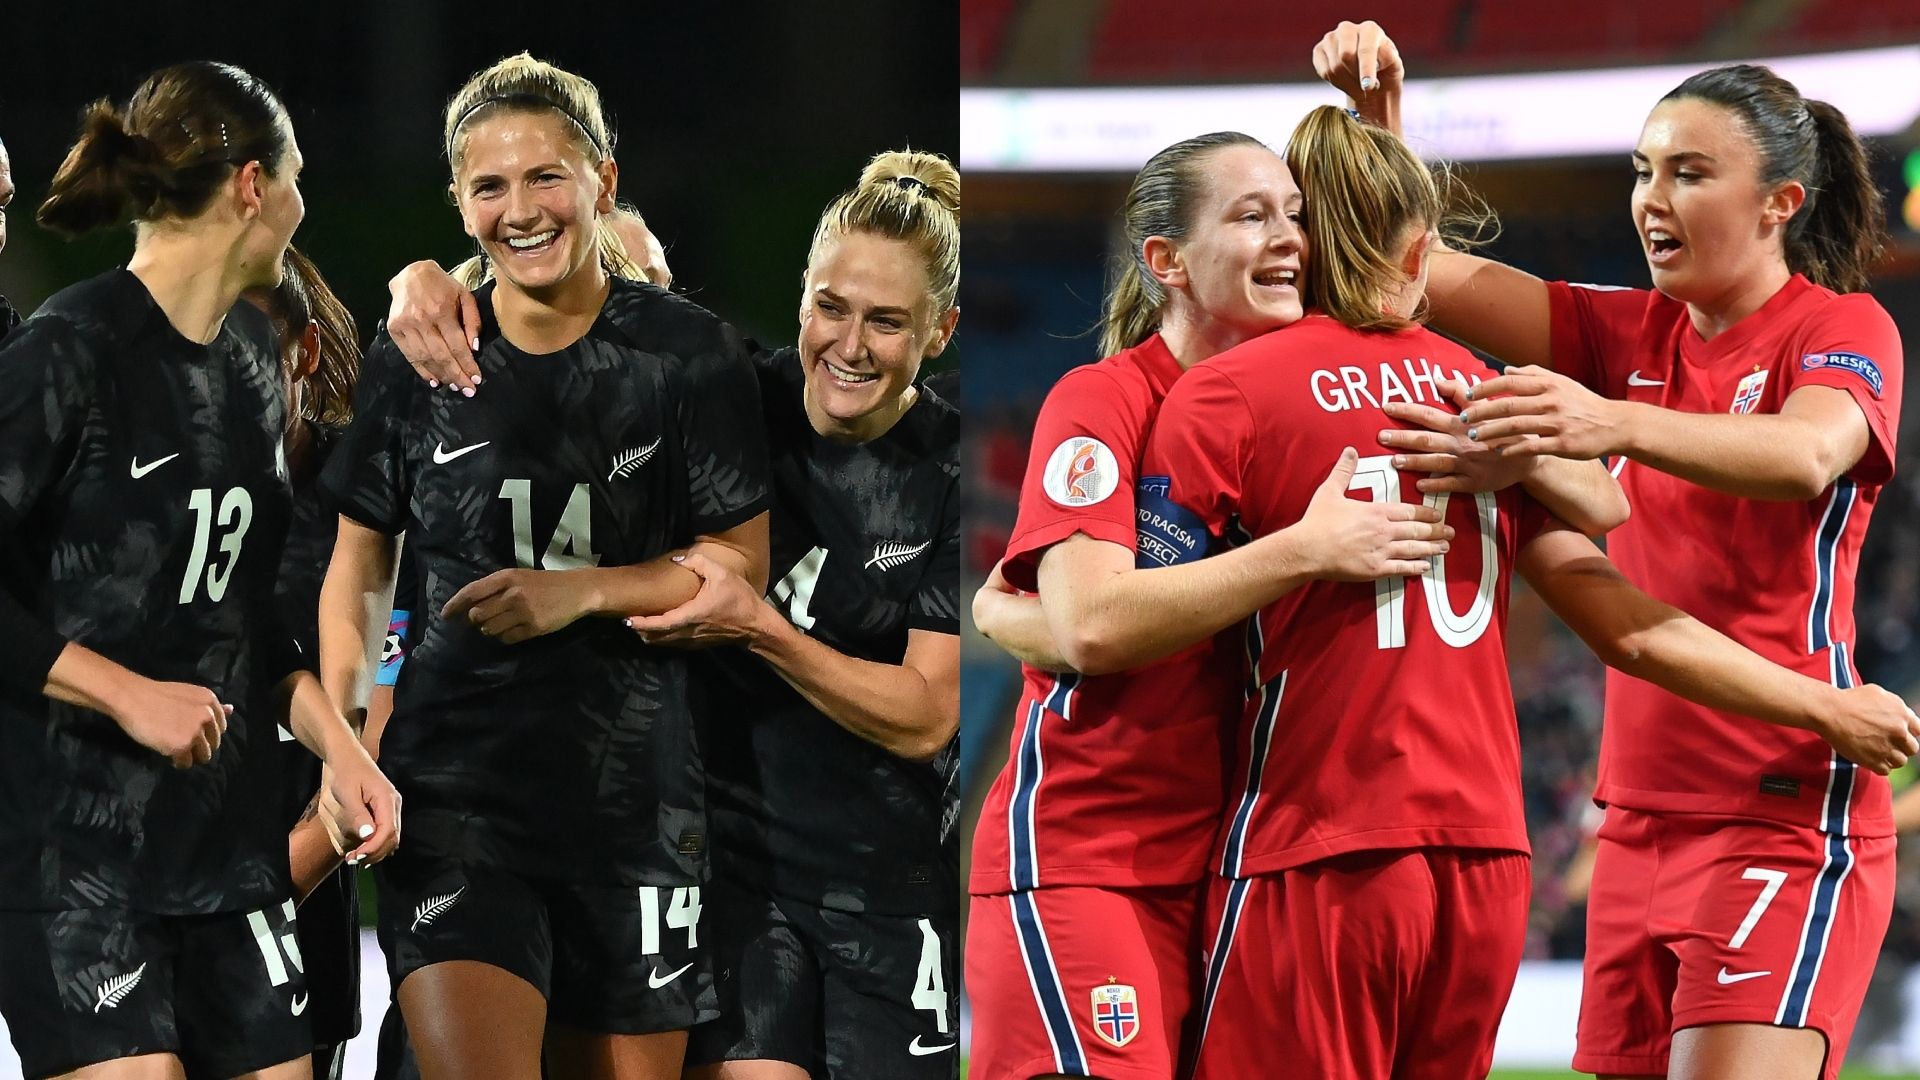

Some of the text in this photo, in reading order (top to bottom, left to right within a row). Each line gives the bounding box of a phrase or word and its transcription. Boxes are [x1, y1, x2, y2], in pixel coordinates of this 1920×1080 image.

[1829, 355, 1882, 390] RESPECT
[179, 487, 252, 604] 13
[498, 479, 602, 571] 14
[1136, 534, 1180, 565] ESPECT
[1150, 514, 1196, 551] RACISM
[1346, 454, 1498, 649] 10
[638, 886, 703, 955] 14
[1726, 867, 1789, 949] 7
[910, 918, 949, 1034] 4
